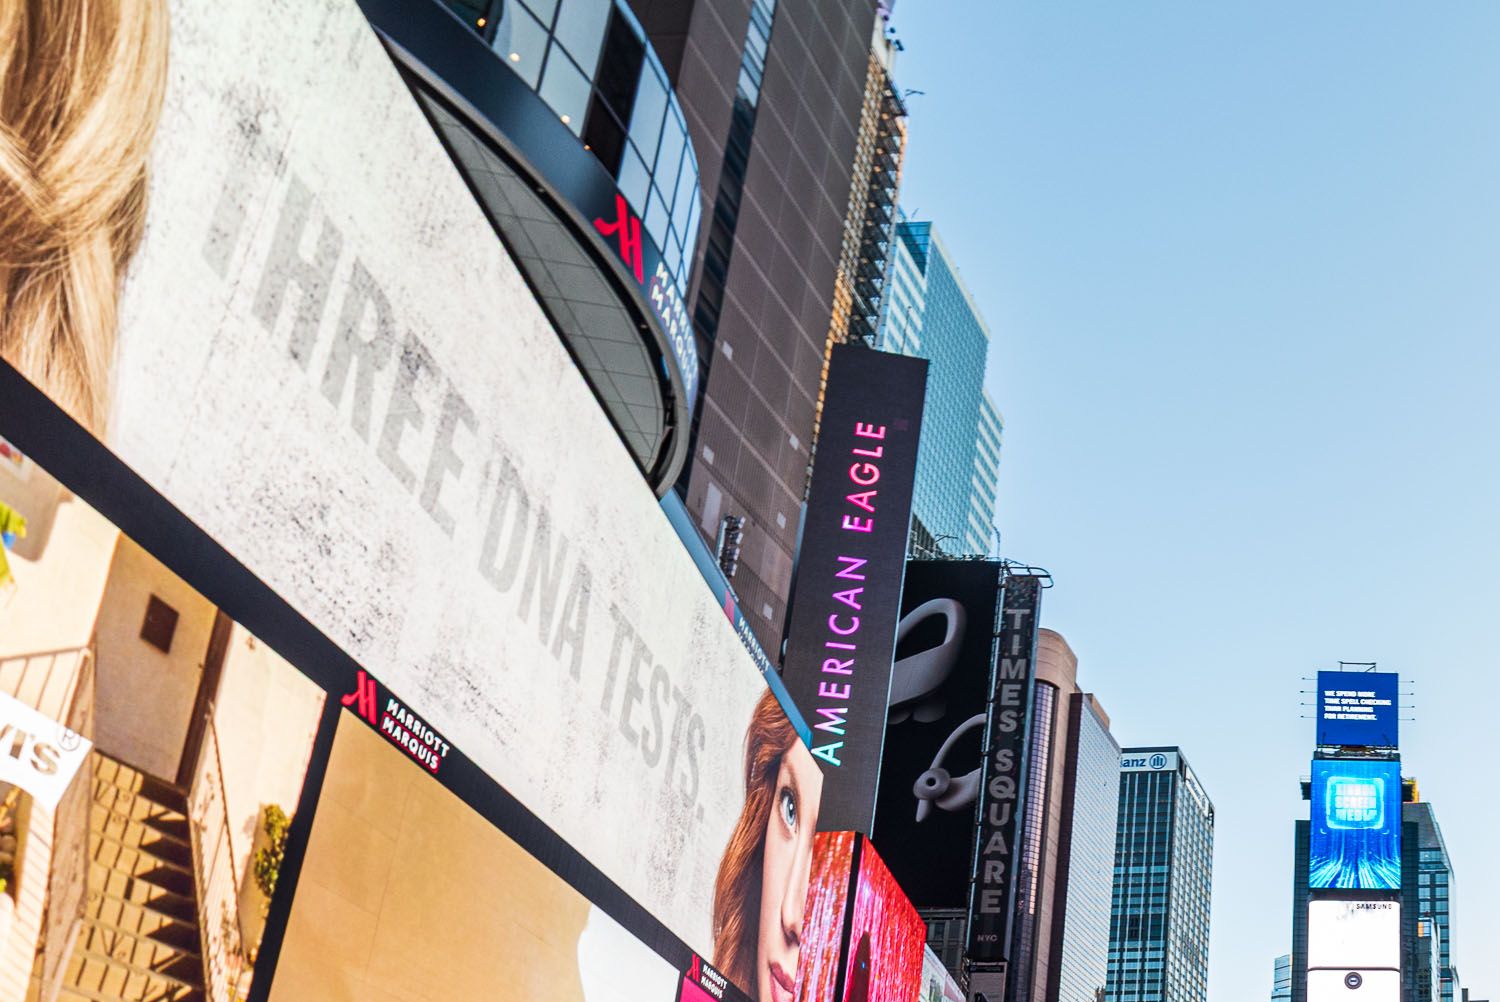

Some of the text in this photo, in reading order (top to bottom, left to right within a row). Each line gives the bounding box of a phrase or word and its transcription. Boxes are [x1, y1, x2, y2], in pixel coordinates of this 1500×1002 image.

[842, 421, 886, 533] EAGLE
[478, 437, 594, 684] DNA
[811, 556, 868, 767] AMERICAN
[998, 608, 1031, 733] TIMES
[382, 717, 439, 772] MARQUIS
[386, 699, 450, 757] MARRIOTT
[979, 748, 1017, 915] SQUARE
[702, 964, 728, 990] MARRIOTT
[977, 934, 998, 943] NYC
[700, 975, 723, 999] MARQUIS
